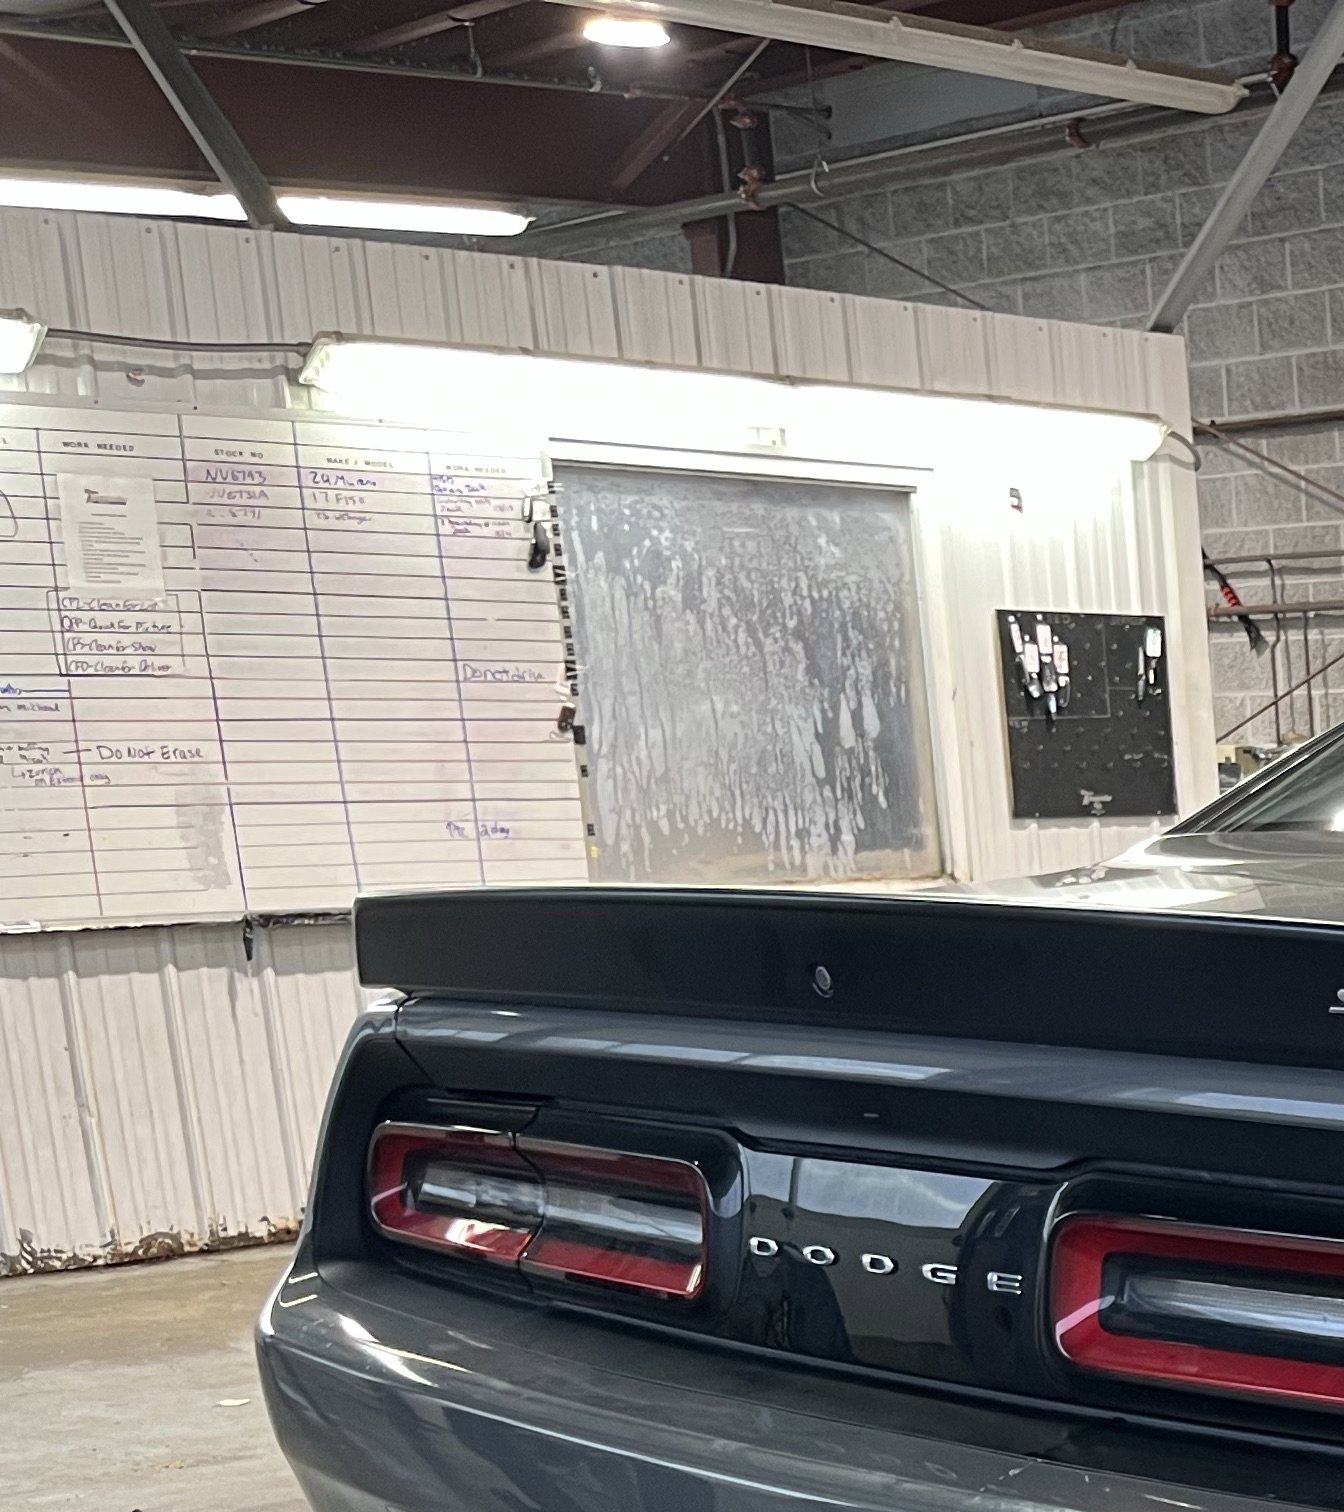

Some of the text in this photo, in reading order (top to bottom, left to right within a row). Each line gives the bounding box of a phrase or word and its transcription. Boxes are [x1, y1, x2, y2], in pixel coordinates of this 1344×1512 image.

[62, 441, 90, 449] WORK
[214, 448, 243, 458] STOCK
[96, 745, 204, 760] Do Not Erase
[750, 1236, 1022, 1295] DODGE
